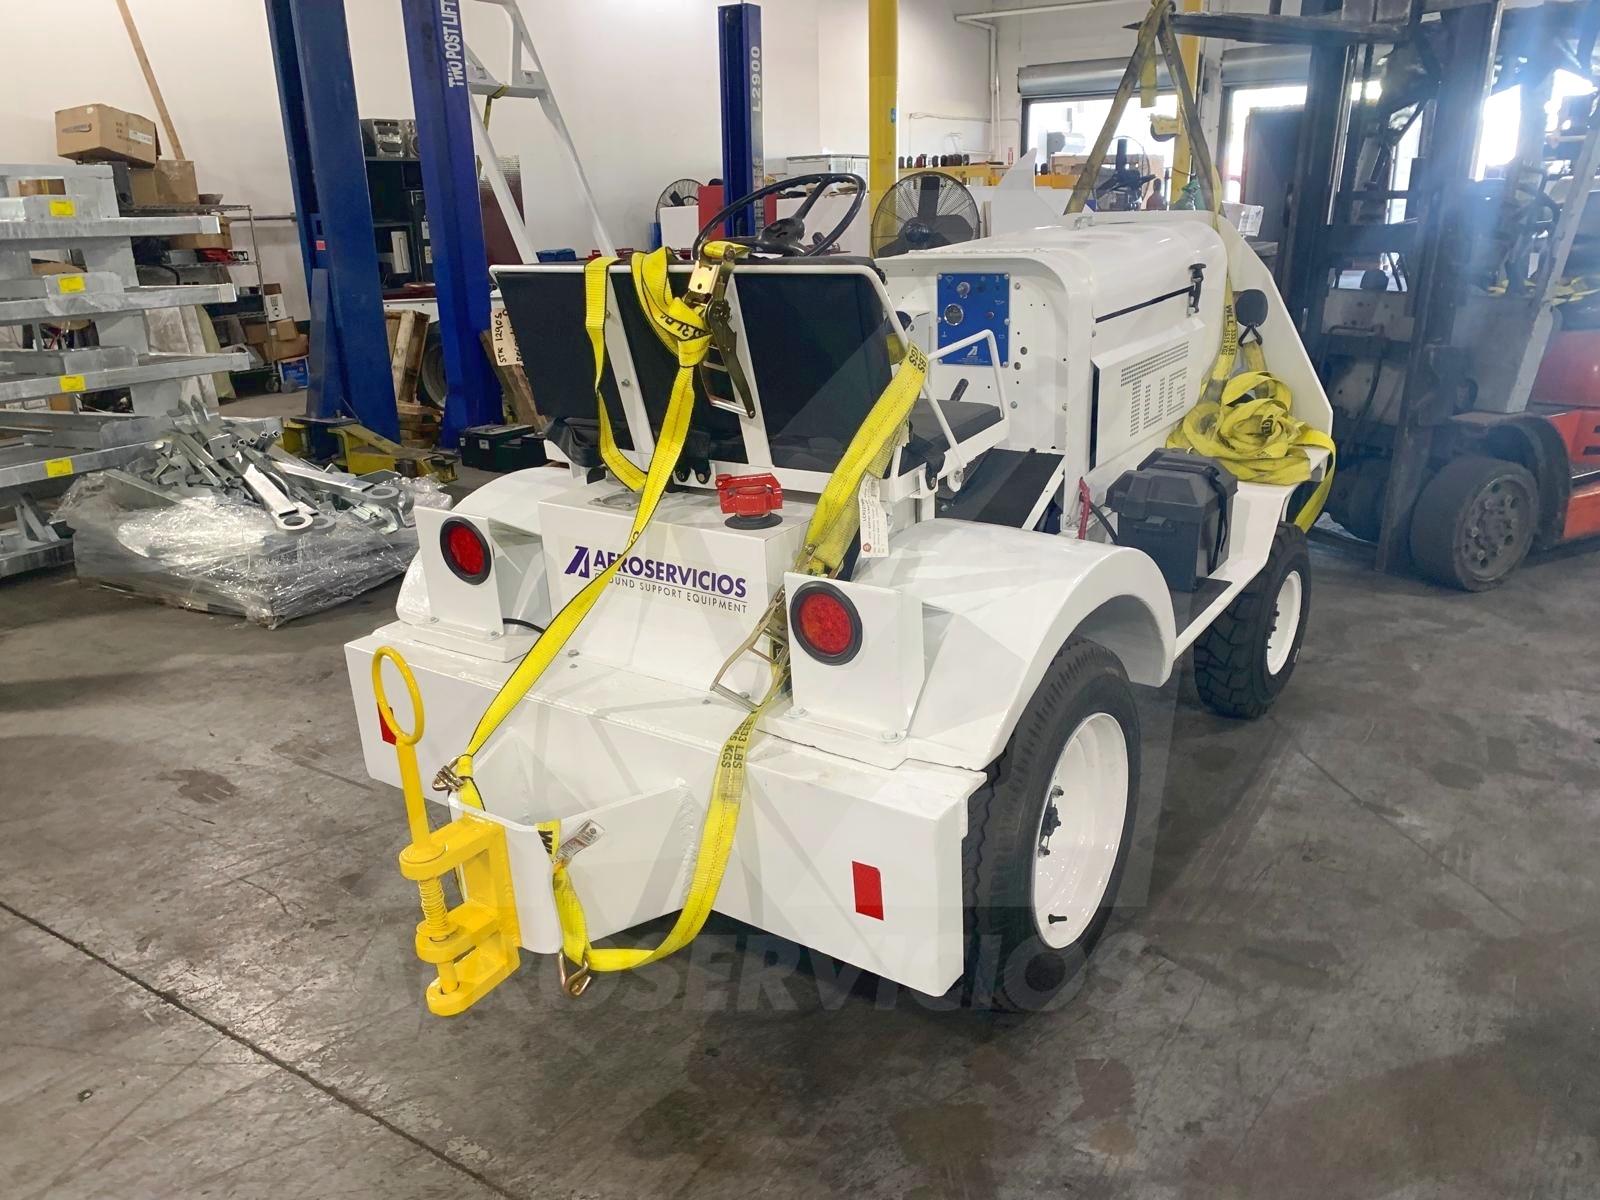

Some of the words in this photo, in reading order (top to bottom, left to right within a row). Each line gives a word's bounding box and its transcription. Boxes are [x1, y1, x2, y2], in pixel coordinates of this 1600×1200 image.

[440, 0, 459, 26] LIFT
[443, 26, 462, 60] POST
[446, 61, 465, 88] TWO
[750, 46, 761, 112] L2900
[497, 346, 507, 363] STK
[1120, 340, 1189, 438] TUG
[639, 583, 683, 600] SUPPORT
[686, 593, 748, 614] EQUIPMENT
[720, 744, 735, 769] KGS
[732, 744, 745, 769] LBS
